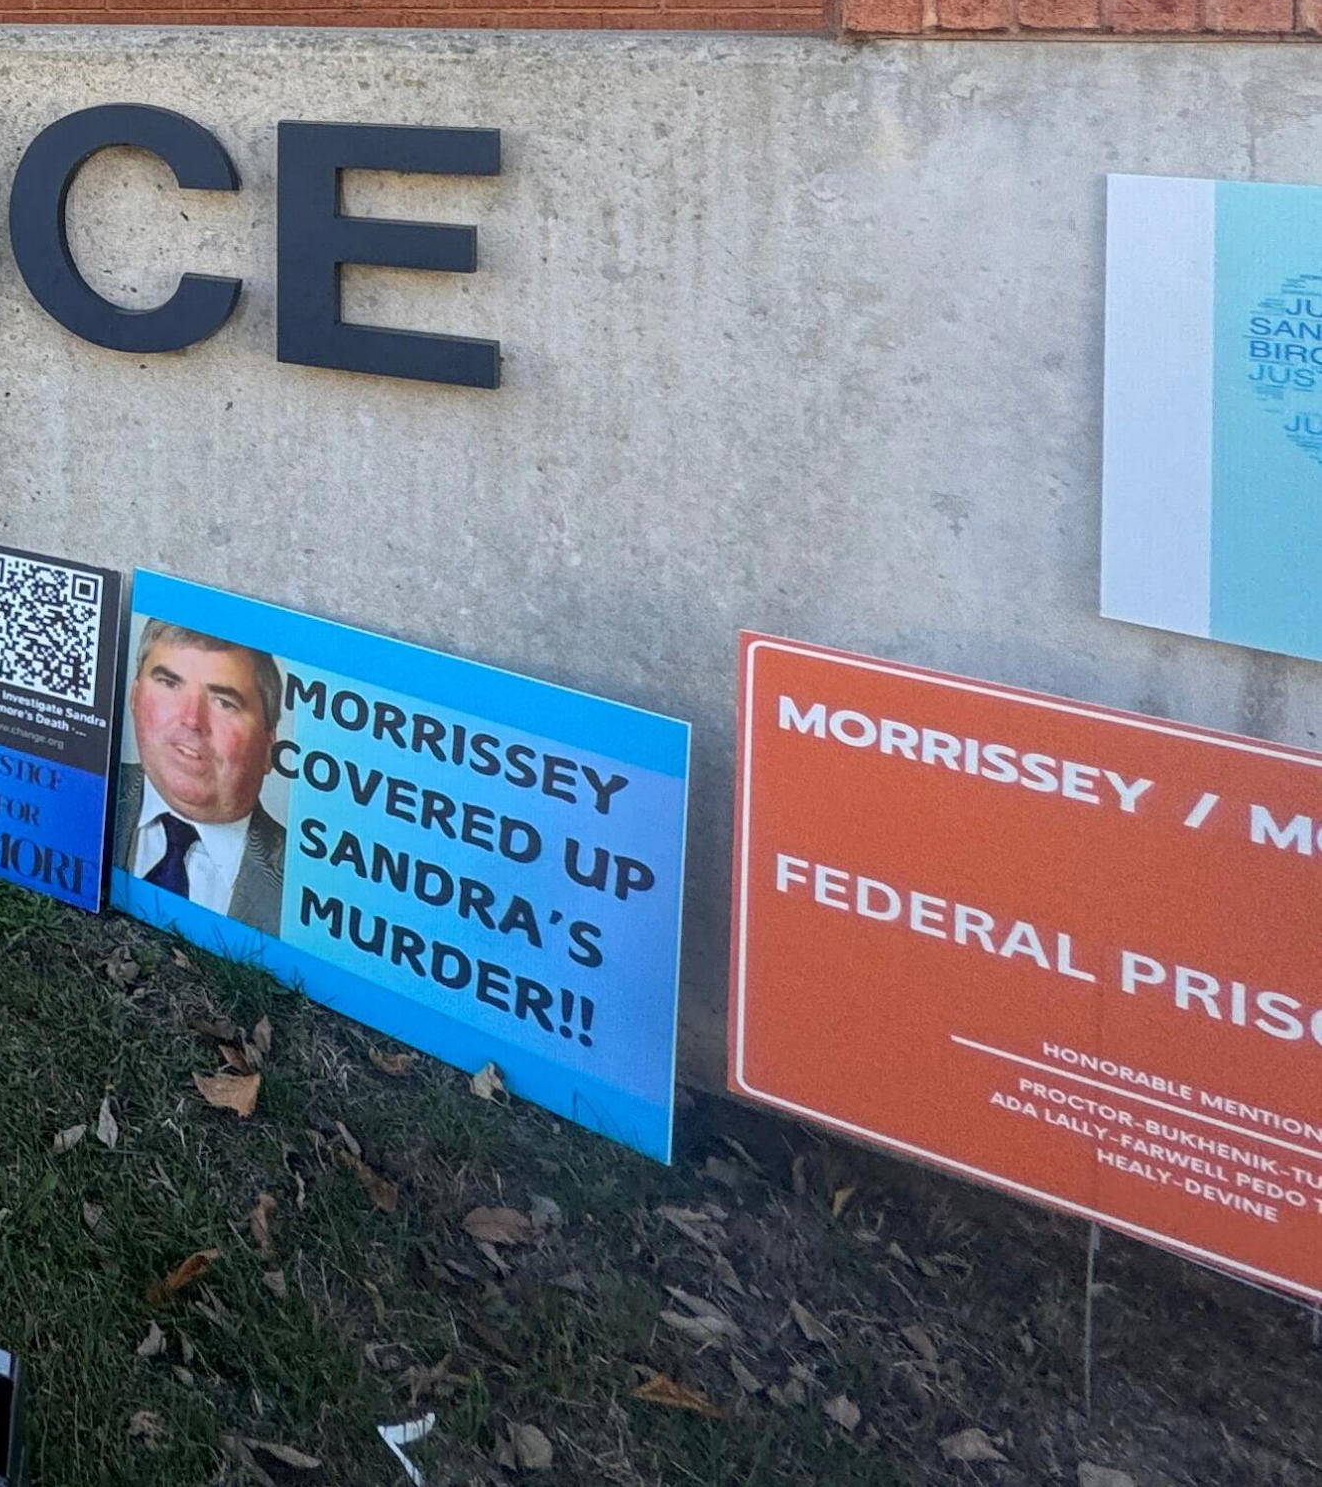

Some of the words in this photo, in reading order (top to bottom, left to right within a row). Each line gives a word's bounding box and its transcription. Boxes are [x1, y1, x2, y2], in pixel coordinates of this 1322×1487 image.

[2, 689, 64, 716] Investigate
[65, 707, 107, 728] Sandra
[35, 713, 70, 732] Death
[285, 672, 629, 815] MORRISSEY
[777, 695, 1155, 814] MORRISSEY
[1249, 804, 1322, 856] M
[270, 739, 543, 865] COVERED
[564, 837, 656, 901] UP
[299, 817, 604, 969] SANDRA'S
[775, 852, 1097, 983] FEDERAL
[1120, 949, 1322, 1050] PRIS
[300, 885, 595, 1048] MURDER!!
[1042, 1041, 1193, 1101] HONORABLE
[989, 1091, 1039, 1119] ADA
[1044, 1107, 1229, 1183] LALLY-FARWELL
[1236, 1172, 1307, 1208] PEDO
[1096, 1147, 1280, 1224] HEALY-DEVINE
